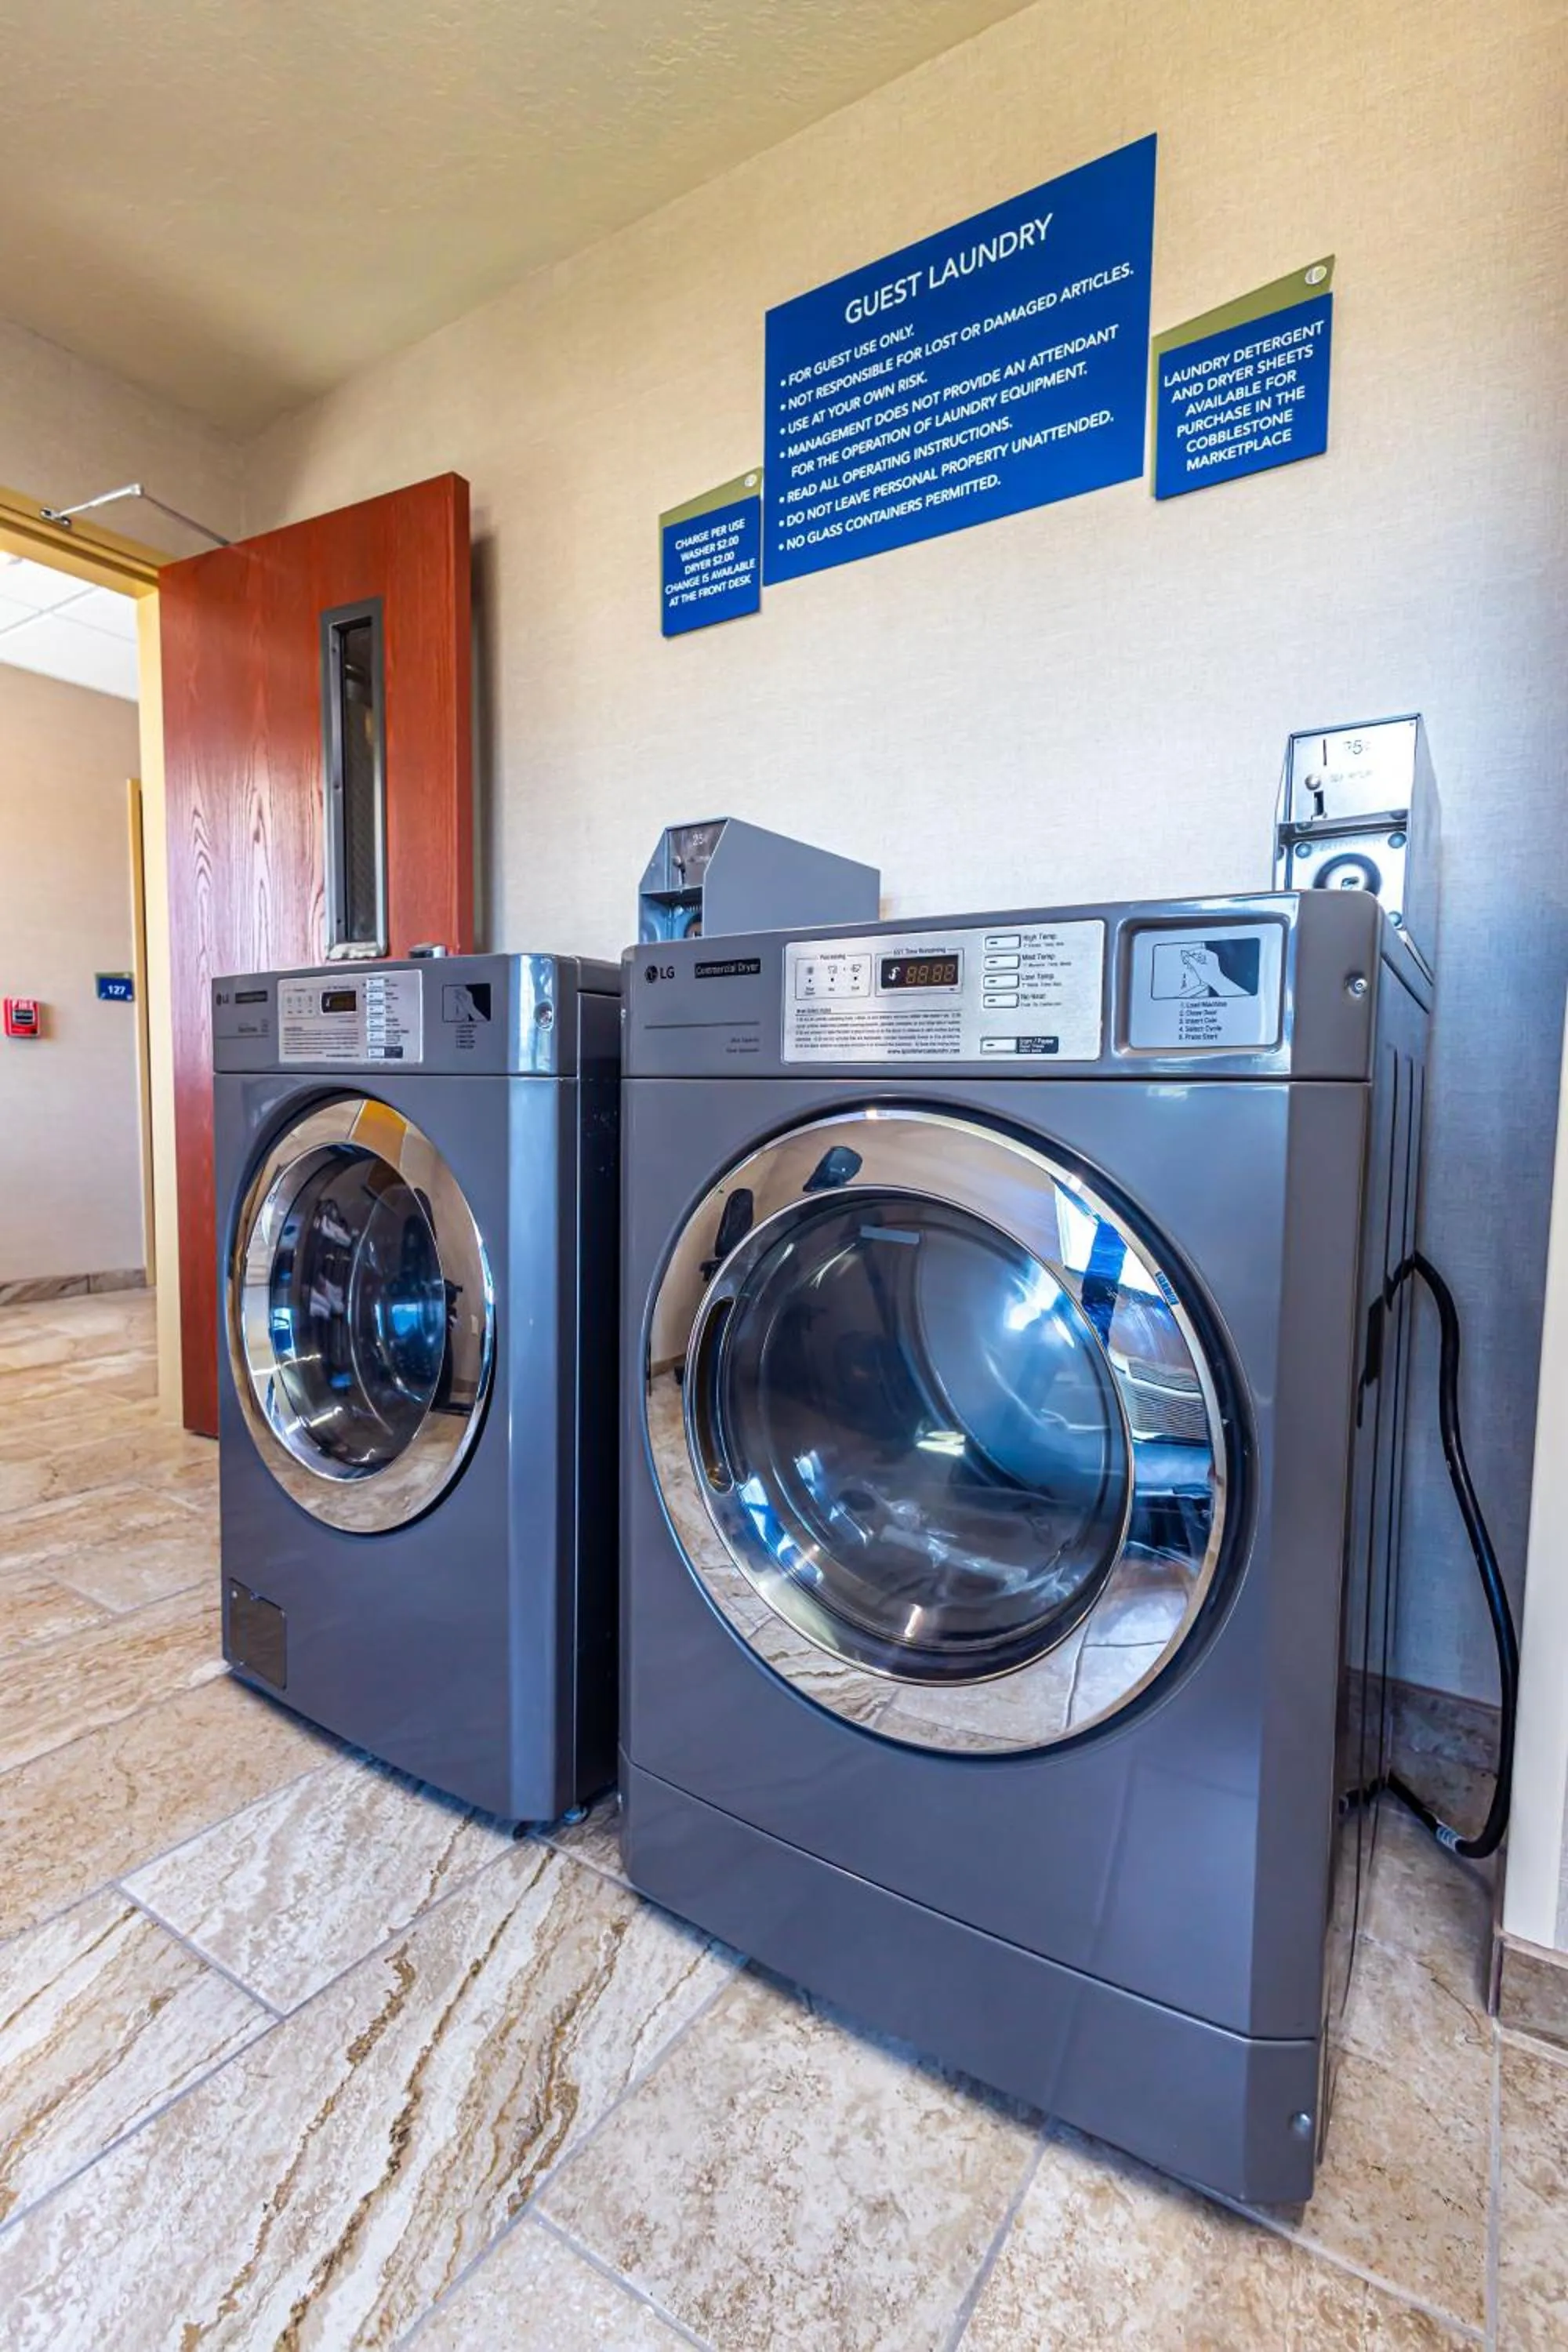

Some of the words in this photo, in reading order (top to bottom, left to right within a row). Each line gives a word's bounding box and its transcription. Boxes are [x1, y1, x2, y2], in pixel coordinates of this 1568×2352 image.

[845, 271, 921, 323] GUEST
[929, 212, 1052, 289] LAUNDRY
[788, 390, 813, 409] NOT
[815, 358, 892, 398] RESPONSIBLE
[896, 347, 922, 366] FOR
[925, 332, 957, 355] LOST
[960, 323, 980, 340] OR
[984, 292, 1057, 332] DAMAGED
[1060, 262, 1133, 301] ARTICLES.
[789, 366, 811, 385] FOR
[813, 349, 851, 375] GUEST
[854, 339, 876, 358] USE
[879, 324, 913, 347] ONLY.
[1164, 354, 1229, 387] LAUNDRY
[1233, 320, 1323, 362] DETERGENT
[788, 416, 872, 458] MANAGEMENT
[874, 402, 908, 426] DOES
[912, 391, 940, 412] NOT
[943, 368, 1000, 400] PROVIDE
[1004, 359, 1025, 378] AN
[1028, 324, 1118, 369] ATTENDANT
[1171, 382, 1203, 402] AND
[1207, 365, 1253, 390] DRYER
[1257, 344, 1312, 373] SHEETS
[1185, 380, 1261, 416] AVAILABLE
[1265, 369, 1296, 390] FOR
[788, 416, 808, 434] USE
[811, 409, 825, 425] AT
[828, 396, 860, 417] YOUR
[863, 383, 894, 405] OWN
[898, 371, 927, 391] RISK.
[791, 459, 814, 477] FOR
[816, 451, 838, 467] THE
[841, 425, 910, 459] OPERATION
[913, 416, 931, 434] OF
[935, 394, 997, 426] LAUNDRY
[1000, 361, 1087, 403] EQUIPMENT.
[1177, 403, 1251, 437] PURCHASE
[1255, 396, 1271, 412] IN
[1276, 385, 1305, 405] THE
[1186, 408, 1292, 452] COBBLESTONE
[786, 511, 804, 526] DO
[807, 501, 832, 520] NOT
[835, 488, 870, 510] LEAVE
[873, 468, 938, 498] PERSONAL
[941, 443, 1008, 476] PROPERTY
[1011, 410, 1113, 452] UNATTENDED.
[787, 483, 817, 502] READ
[819, 476, 840, 492] ALL
[842, 451, 910, 483] OPERATING
[913, 416, 1012, 459] INSTRUCTIONS.
[1186, 428, 1290, 470] MARKETPLACE
[675, 531, 709, 549] CHARGE
[710, 524, 726, 537] PER
[728, 518, 744, 532] USE
[786, 535, 804, 550] NO
[807, 522, 842, 543] GLASS
[844, 497, 922, 531] CONTAINERS
[925, 474, 1000, 506] PERMITTED.
[665, 575, 699, 594] CHANGE
[702, 573, 709, 583] IS
[710, 557, 754, 580] AVAILABLE
[681, 543, 715, 561] WASHER
[717, 535, 739, 550] $2.00
[684, 558, 710, 574] DRYER
[712, 551, 734, 566] $2.00
[669, 596, 679, 606] AT
[681, 590, 696, 602] THE
[698, 581, 726, 597] FRONT
[728, 574, 750, 589] DESK
[107, 984, 125, 995] 127
[660, 967, 675, 979] LG
[696, 962, 736, 976] Commercial
[738, 961, 760, 974] Dryer
